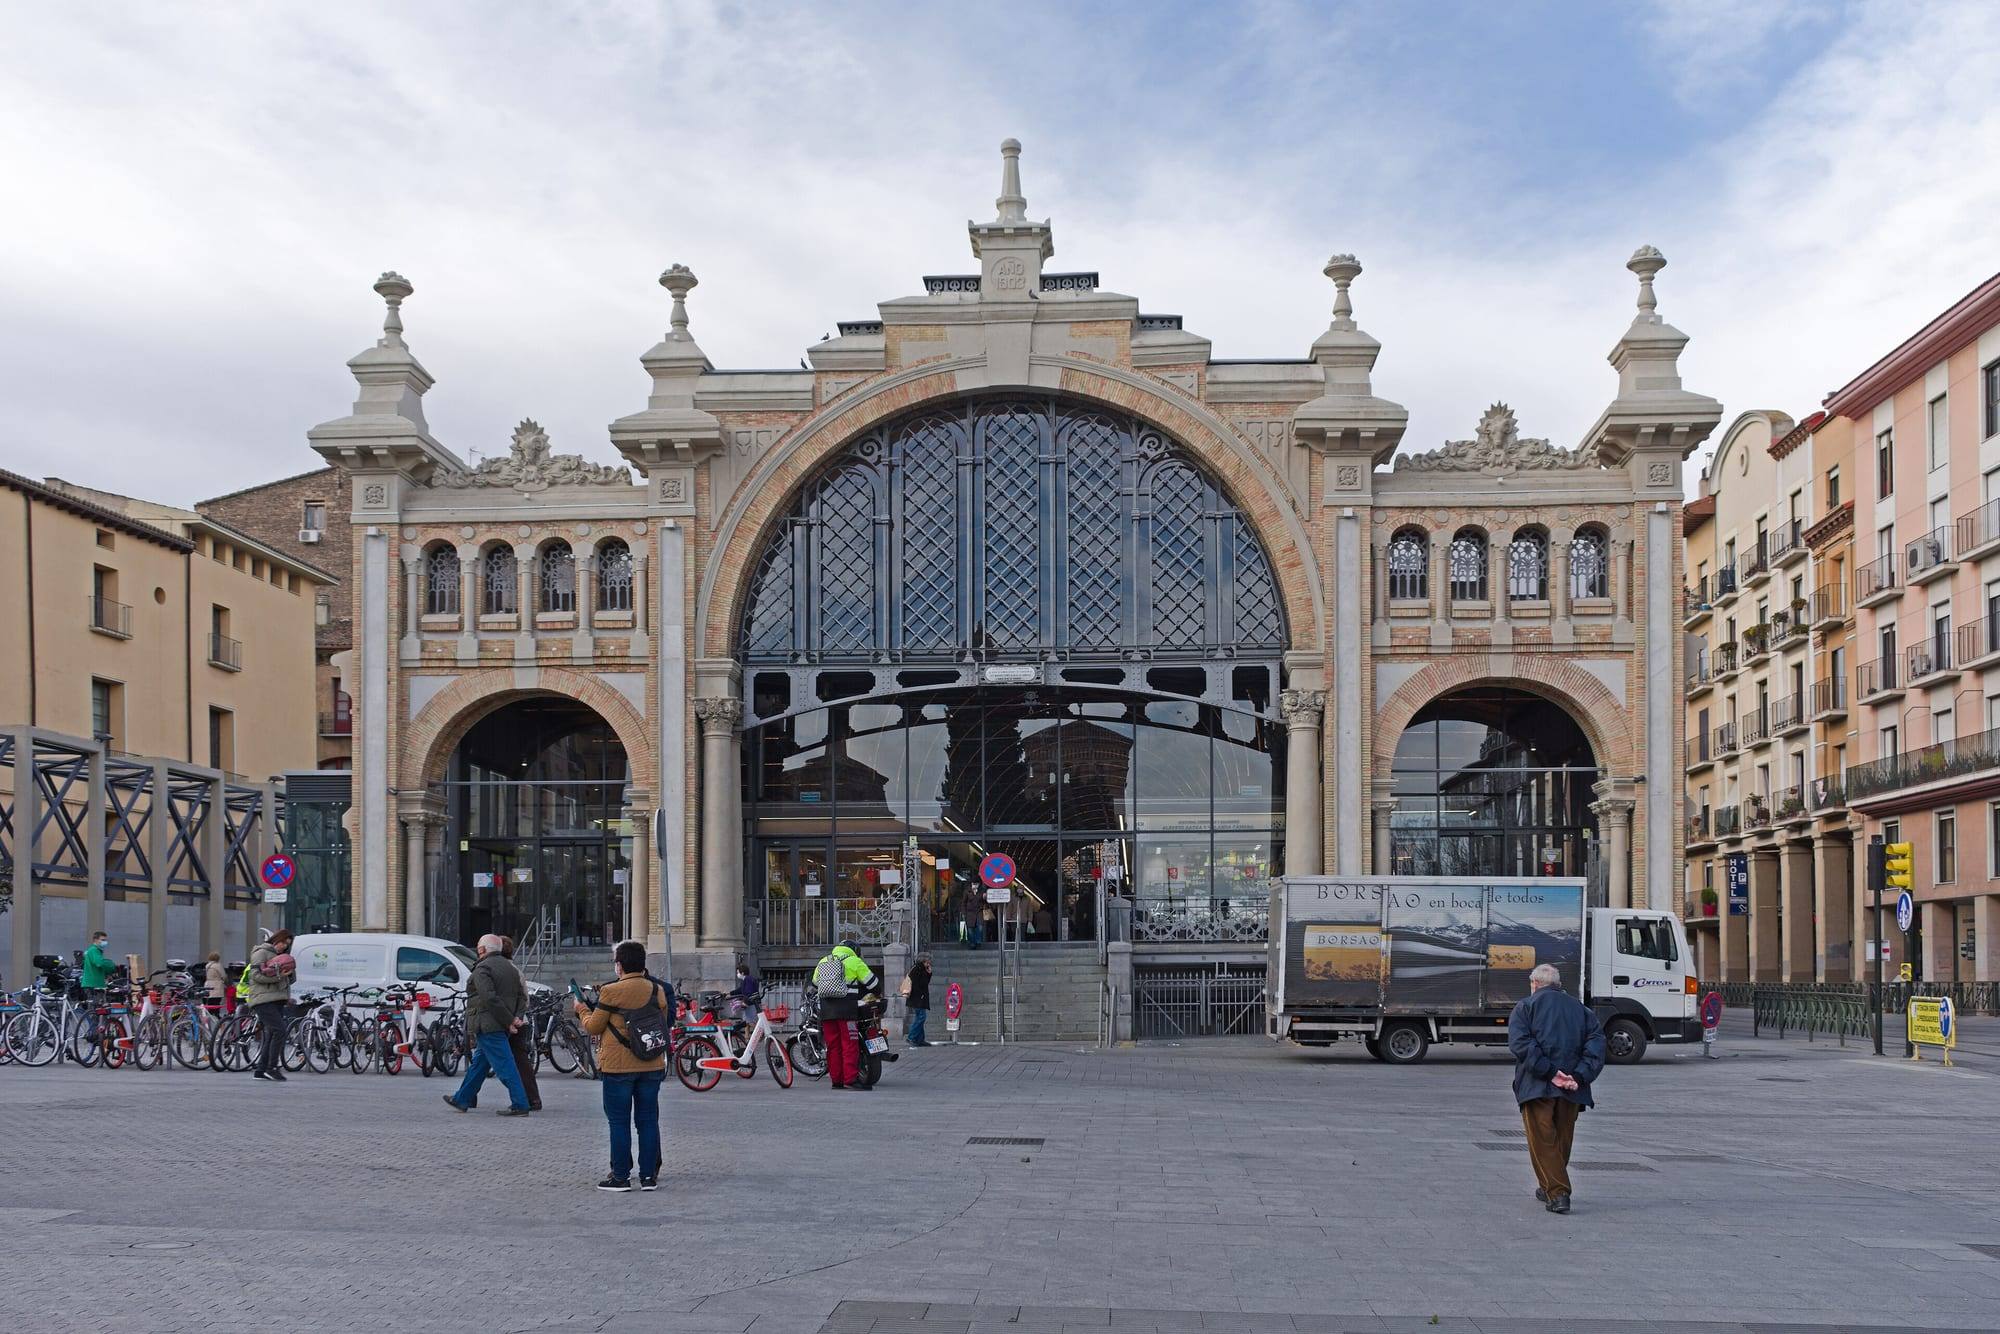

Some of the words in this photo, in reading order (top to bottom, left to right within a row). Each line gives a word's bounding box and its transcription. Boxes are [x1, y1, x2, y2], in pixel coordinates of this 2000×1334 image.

[1429, 899, 1445, 908] en
[1451, 893, 1482, 908] boca
[1507, 887, 1544, 903] todos
[1318, 935, 1380, 945] BORSAO
[1633, 978, 1672, 988] Correas
